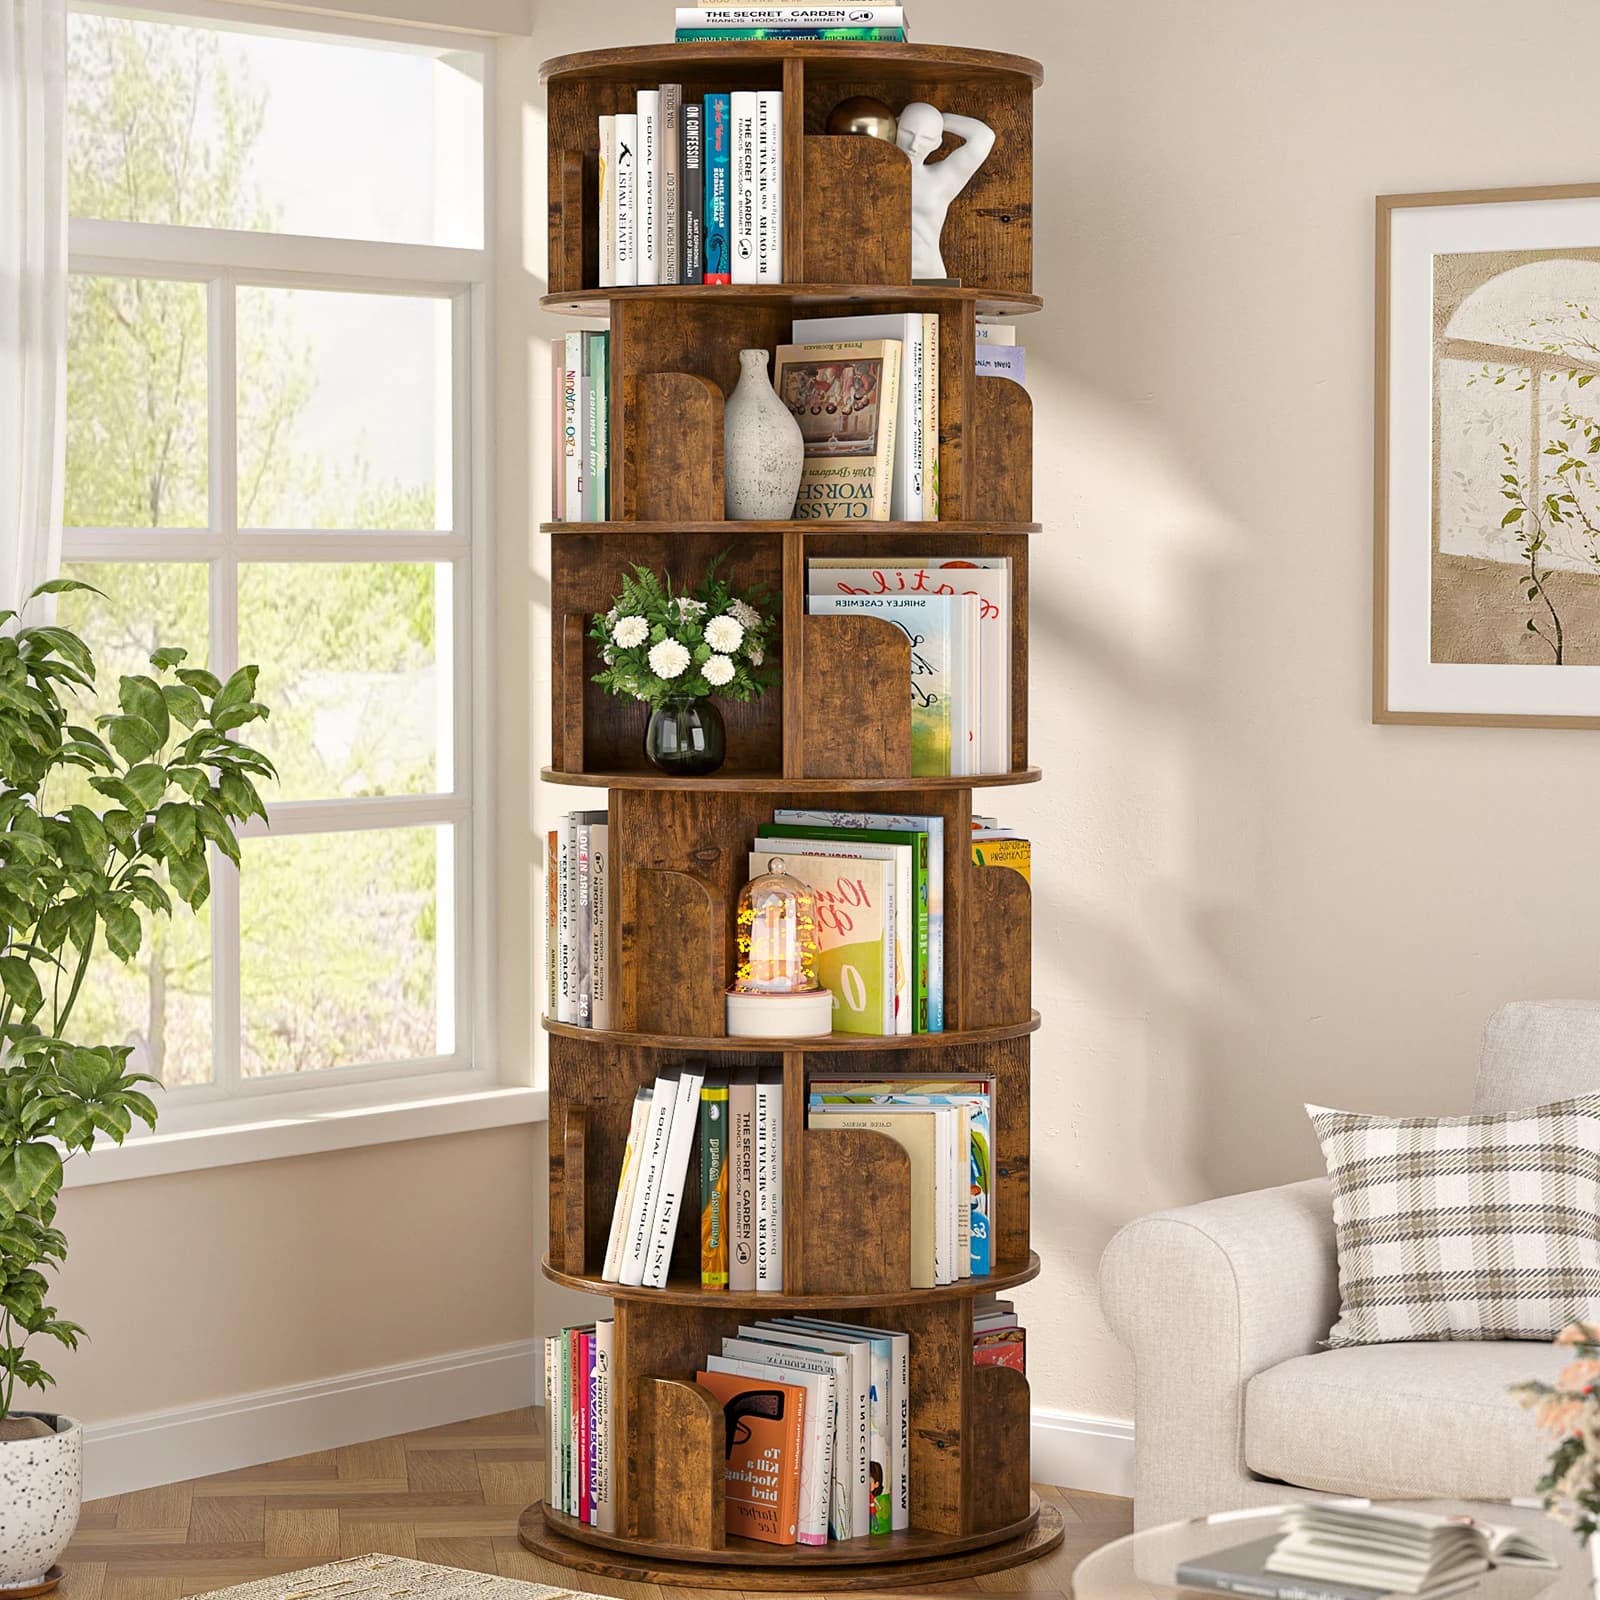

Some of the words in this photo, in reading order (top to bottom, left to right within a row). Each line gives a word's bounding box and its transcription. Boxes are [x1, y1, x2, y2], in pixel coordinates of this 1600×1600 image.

[705, 10, 731, 18] THE
[666, 88, 674, 110] SOLEIL
[686, 106, 698, 118] ON
[666, 112, 674, 128] GINA
[744, 118, 752, 139] THE
[686, 120, 698, 169] CONFESSION
[719, 168, 724, 178] 20
[744, 141, 752, 183] SECRET
[618, 171, 626, 209] TWIST
[666, 172, 674, 186] OUT
[666, 187, 674, 210] INSIDE
[666, 212, 674, 225] THE
[744, 190, 752, 236] GARDEN
[618, 213, 626, 261] OLIVER
[666, 226, 674, 246] FROM
[565, 370, 576, 414] JOAQUIN
[565, 426, 575, 446] ZOO
[809, 467, 850, 478] Brethren
[797, 483, 874, 499] WORSH
[793, 502, 868, 518] CLASSI
[580, 830, 588, 858] LOVE
[580, 860, 588, 872] IN
[580, 874, 588, 906] ARMS
[562, 916, 568, 930] OF
[580, 994, 588, 1017] EX3
[743, 1112, 751, 1135] THE
[759, 1094, 767, 1141] HEALTH
[654, 1107, 666, 1158] SOCIAL
[709, 1138, 720, 1182] World
[743, 1138, 751, 1182] SECRET
[759, 1144, 767, 1192] MENTAL
[634, 1165, 655, 1260] PSYCHOLOGY
[710, 1190, 720, 1248] Fantasy
[743, 1190, 751, 1239] GARDEN
[770, 1193, 778, 1226] Pilgrim
[652, 1244, 665, 1284] OST
[661, 1192, 675, 1234] FISH
[759, 1216, 767, 1279] RECOVERY
